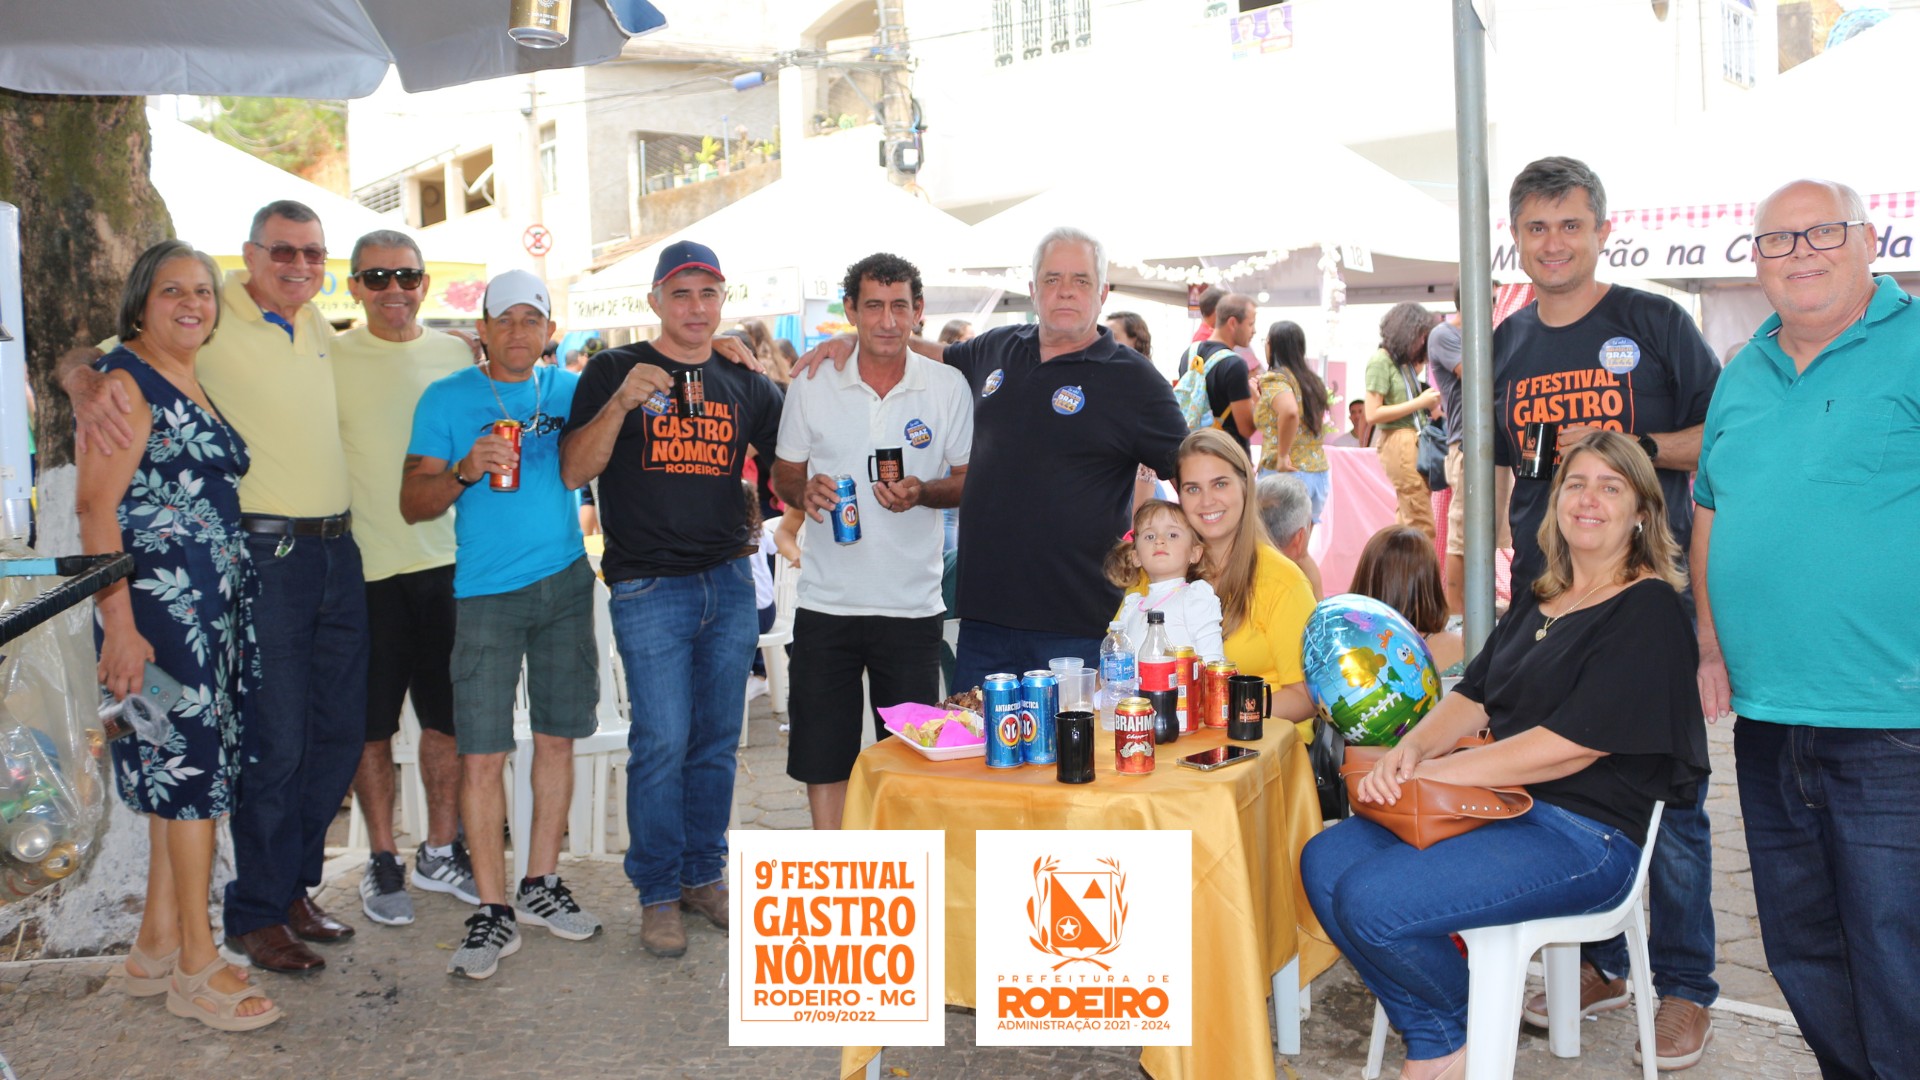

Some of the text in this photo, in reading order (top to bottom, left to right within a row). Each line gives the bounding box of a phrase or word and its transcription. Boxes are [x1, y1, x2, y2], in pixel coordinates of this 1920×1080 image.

[1666, 242, 1704, 266] na
[814, 280, 829, 296] 19
[1531, 368, 1620, 396] FESTIVAL
[1513, 389, 1623, 427] GASTRO
[652, 415, 733, 443] GASTRO
[651, 437, 729, 467] NÔMICO
[665, 463, 721, 477] RODEIRO
